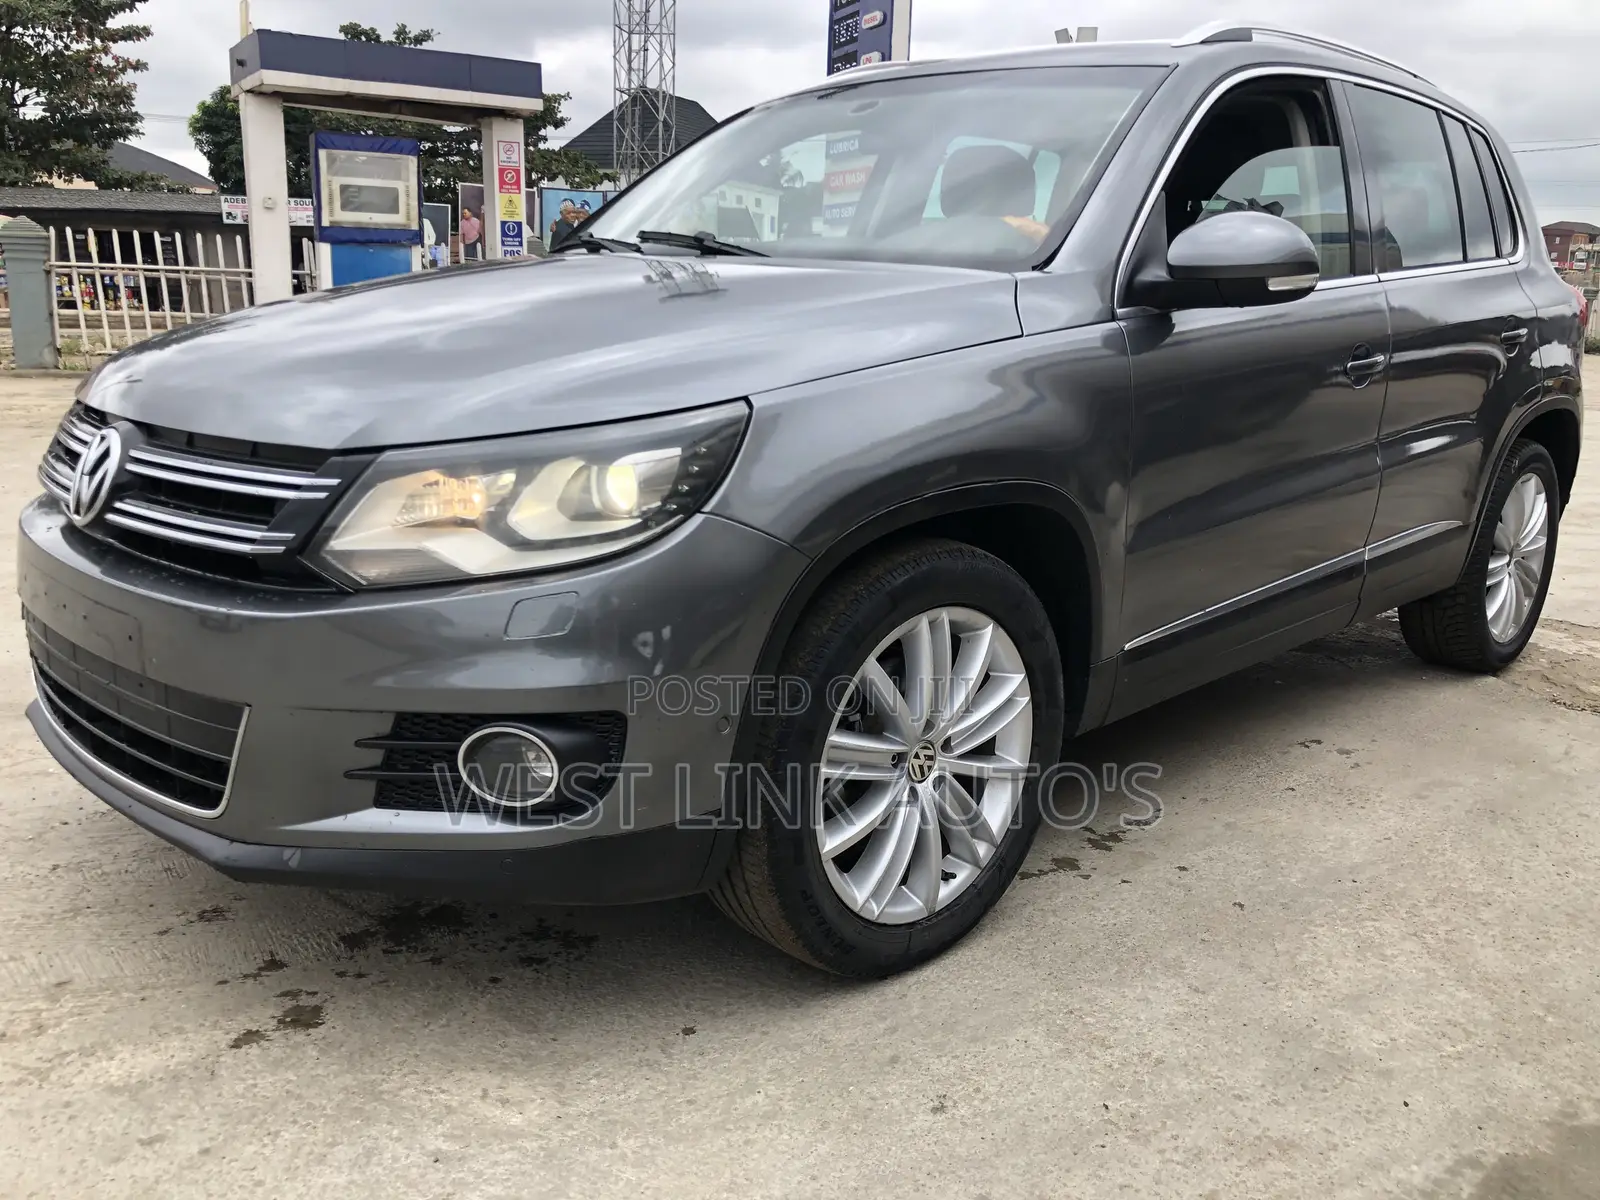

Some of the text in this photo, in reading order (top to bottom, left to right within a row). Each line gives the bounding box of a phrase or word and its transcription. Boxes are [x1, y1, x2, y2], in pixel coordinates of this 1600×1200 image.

[829, 171, 866, 187] CAR WASH
[824, 207, 840, 220] AUTO
